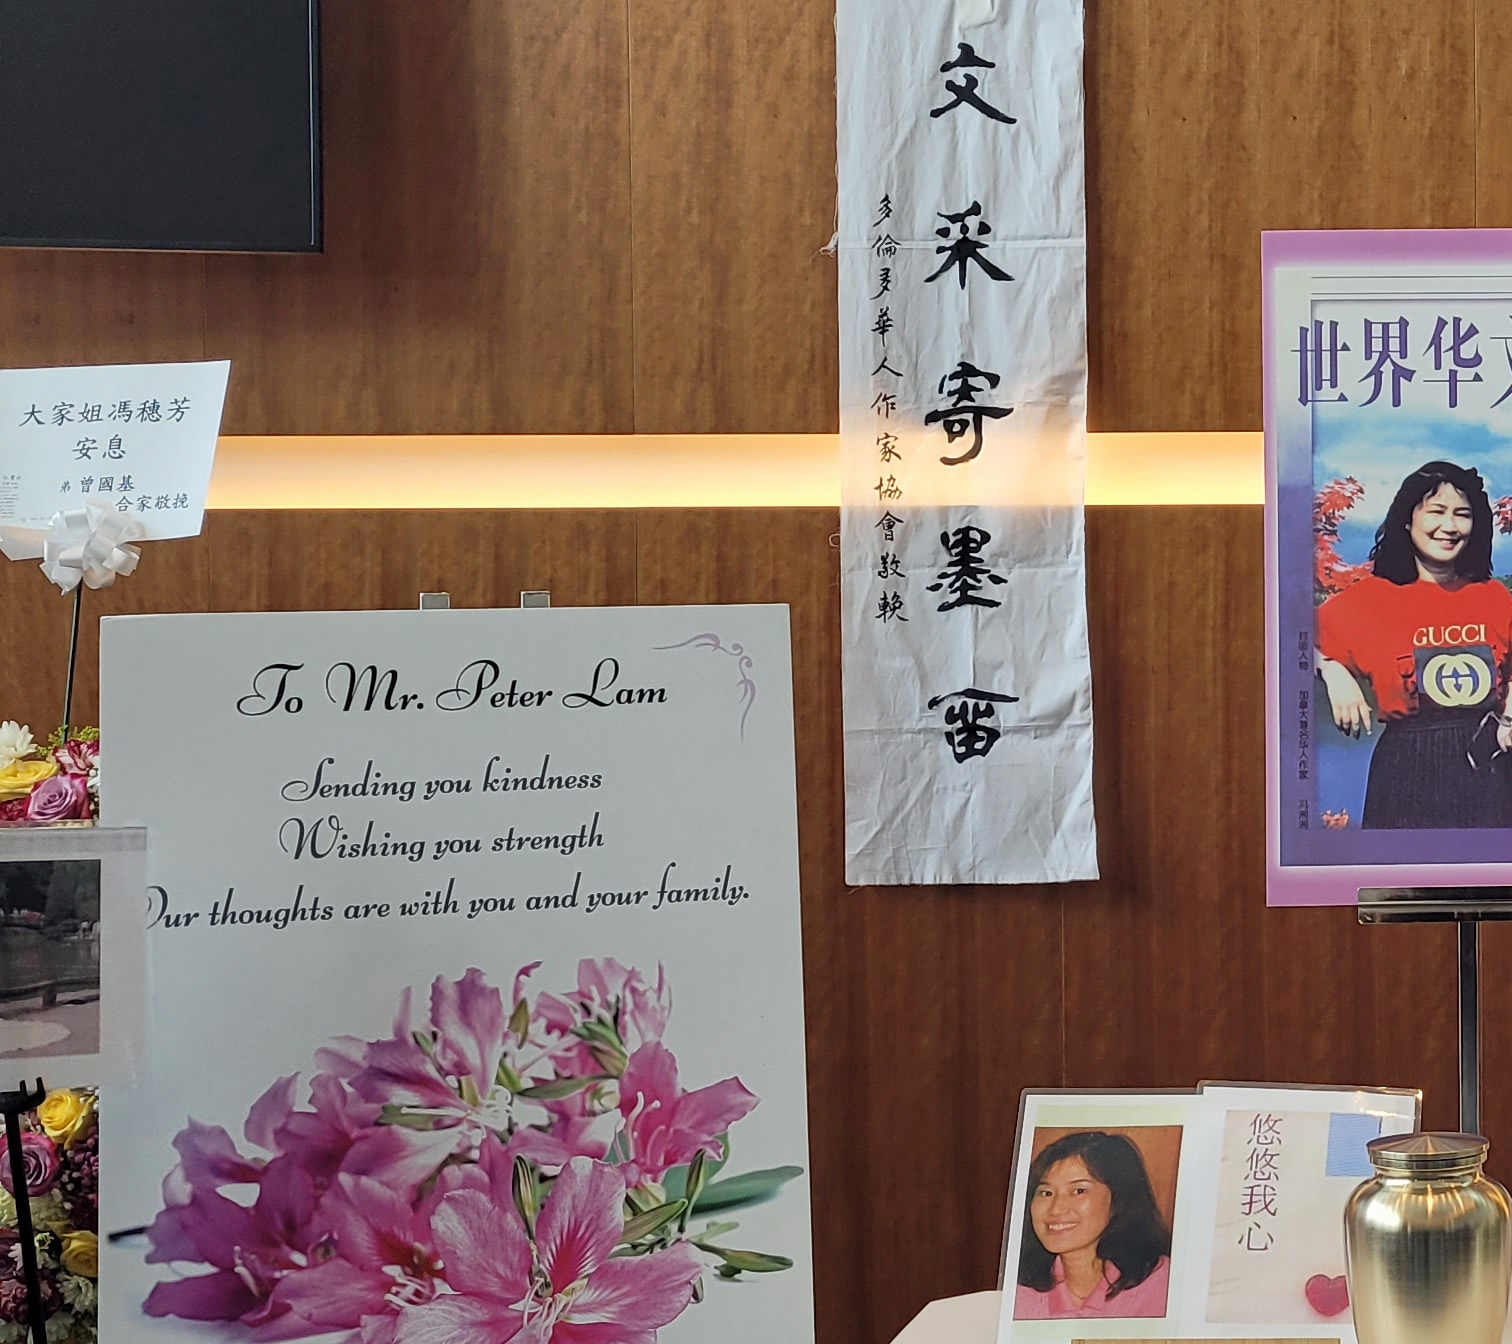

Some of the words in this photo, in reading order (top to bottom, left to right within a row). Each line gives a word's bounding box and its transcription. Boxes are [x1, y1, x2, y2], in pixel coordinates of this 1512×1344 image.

[18, 395, 192, 427] 大家姐馮穗芳
[71, 433, 127, 460] 安息
[1412, 623, 1487, 647] GUCCI
[236, 661, 305, 716] To
[325, 661, 425, 712] Mr.
[435, 658, 553, 712] Peter
[562, 657, 668, 710] Lam
[281, 757, 417, 802] Sending
[422, 775, 473, 802] you
[481, 754, 603, 793] kindness
[279, 814, 425, 863] Wishing
[432, 832, 483, 859] you
[490, 811, 605, 856] strength
[207, 883, 334, 930] thoughts
[343, 896, 391, 920] are
[399, 876, 461, 917] with
[467, 894, 518, 921] you
[525, 871, 580, 911] and
[585, 885, 650, 913] your
[650, 861, 750, 909] family.
[1237, 1113, 1285, 1253] 悠悠我心
